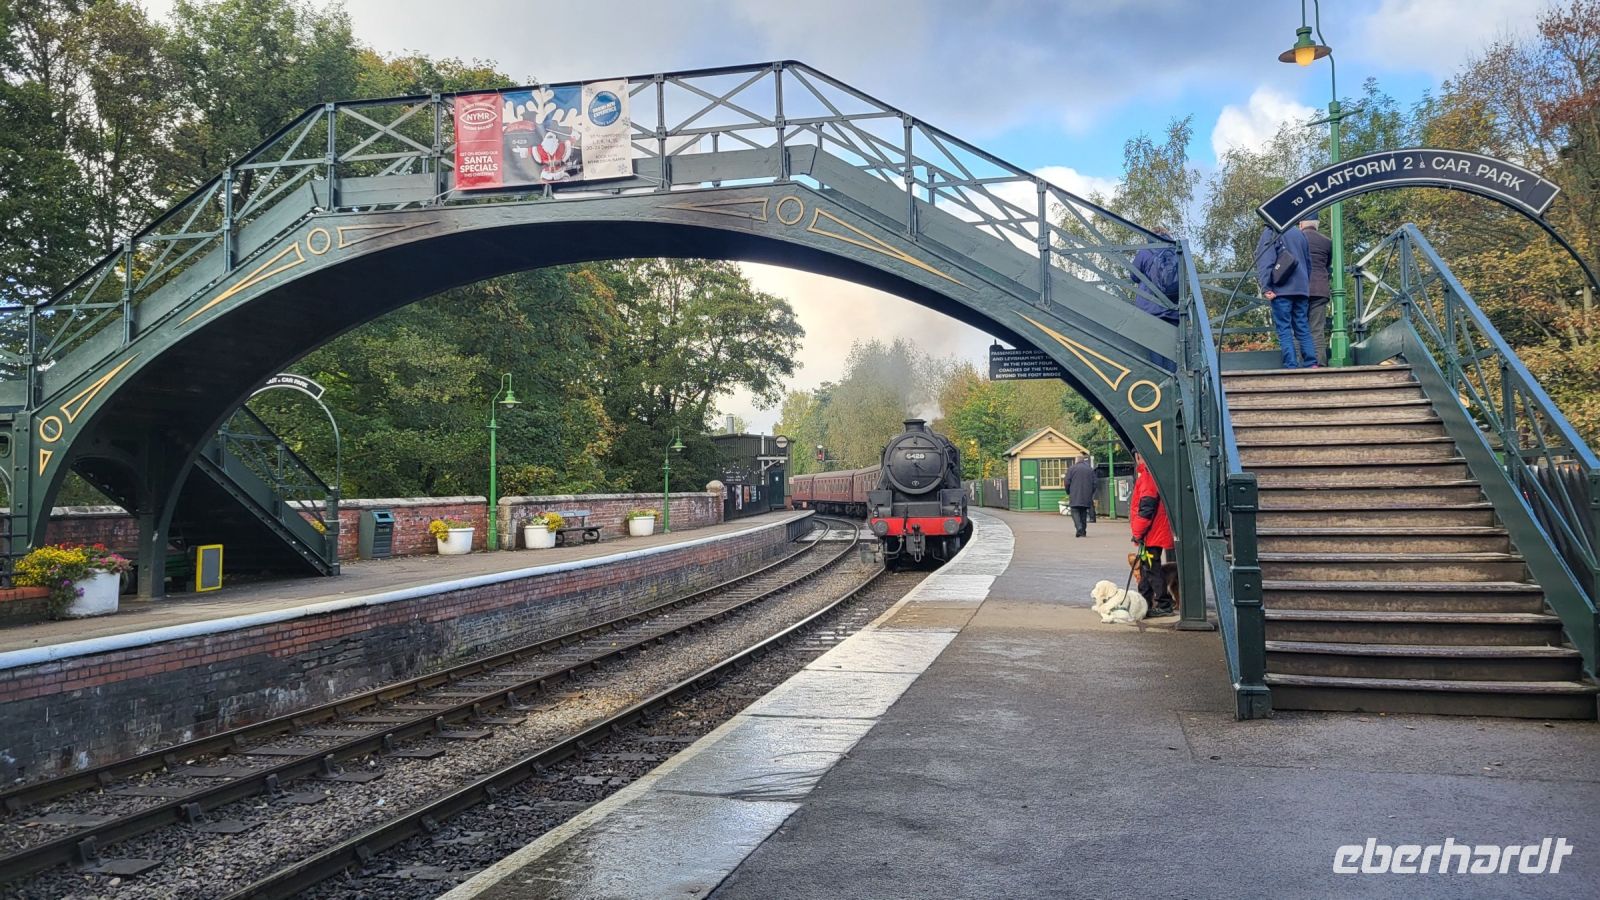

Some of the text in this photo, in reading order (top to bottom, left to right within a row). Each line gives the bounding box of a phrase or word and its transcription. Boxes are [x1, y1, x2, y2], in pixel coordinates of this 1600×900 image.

[466, 112, 490, 121] NYMR
[464, 156, 493, 164] SANTA
[460, 164, 498, 173] SPECIALS
[1292, 196, 1304, 207] TO
[1304, 158, 1396, 199] PLATFORM
[1404, 157, 1414, 170] 2
[1432, 157, 1470, 173] CAR
[1476, 164, 1526, 191] PARK
[294, 379, 308, 388] PARK
